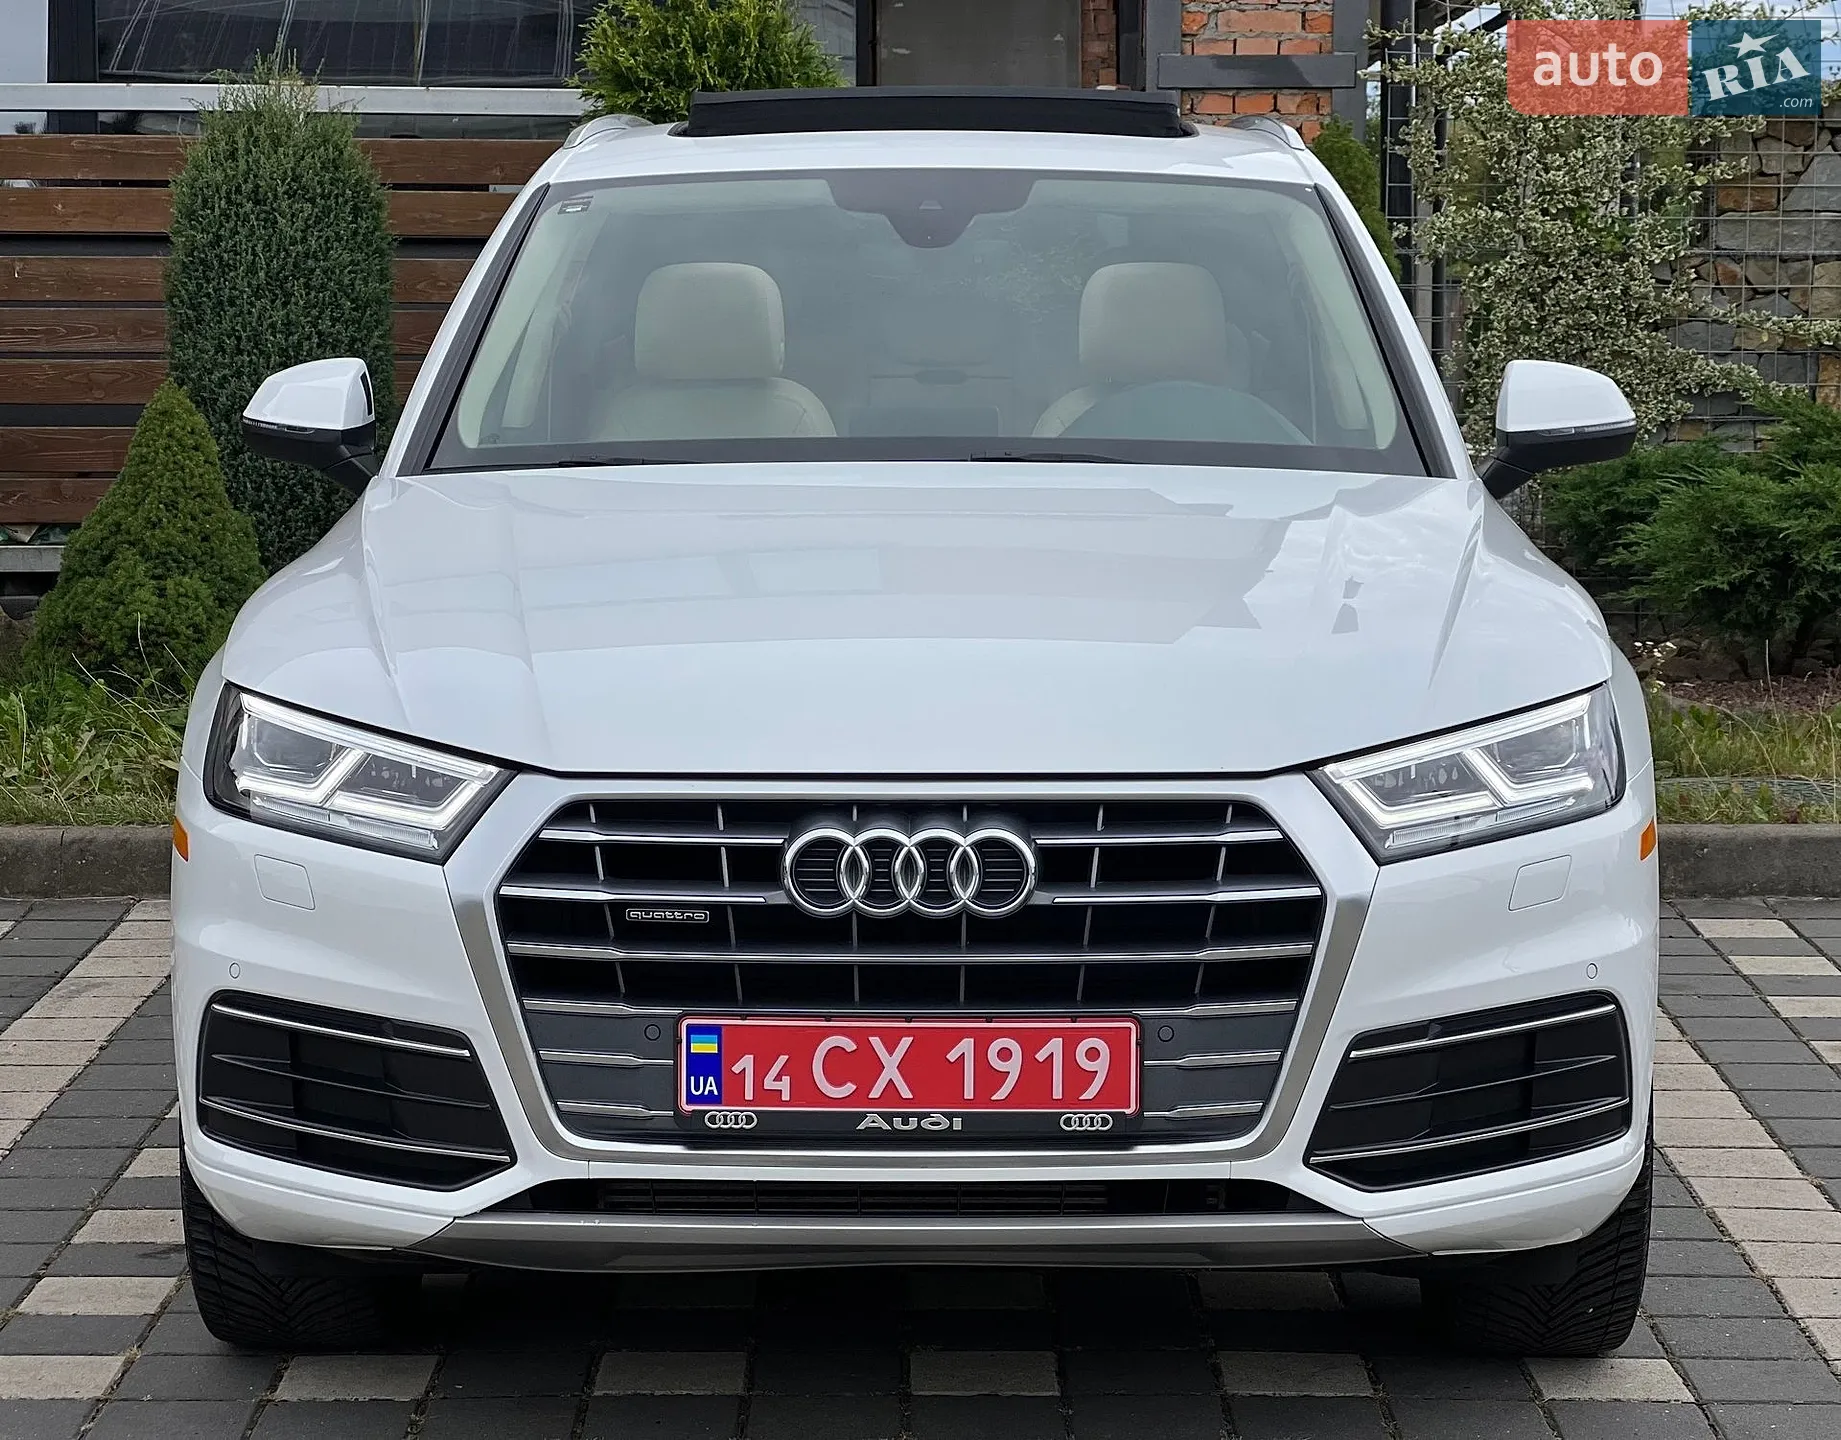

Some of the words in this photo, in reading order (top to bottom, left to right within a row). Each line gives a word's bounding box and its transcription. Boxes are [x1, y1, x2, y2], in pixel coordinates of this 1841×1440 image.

[629, 910, 706, 920] quattro
[731, 1054, 790, 1101] 14
[811, 1035, 914, 1099] CX
[945, 1037, 1111, 1101] 1919
[690, 1076, 719, 1096] UA
[855, 1113, 962, 1131] Audi
